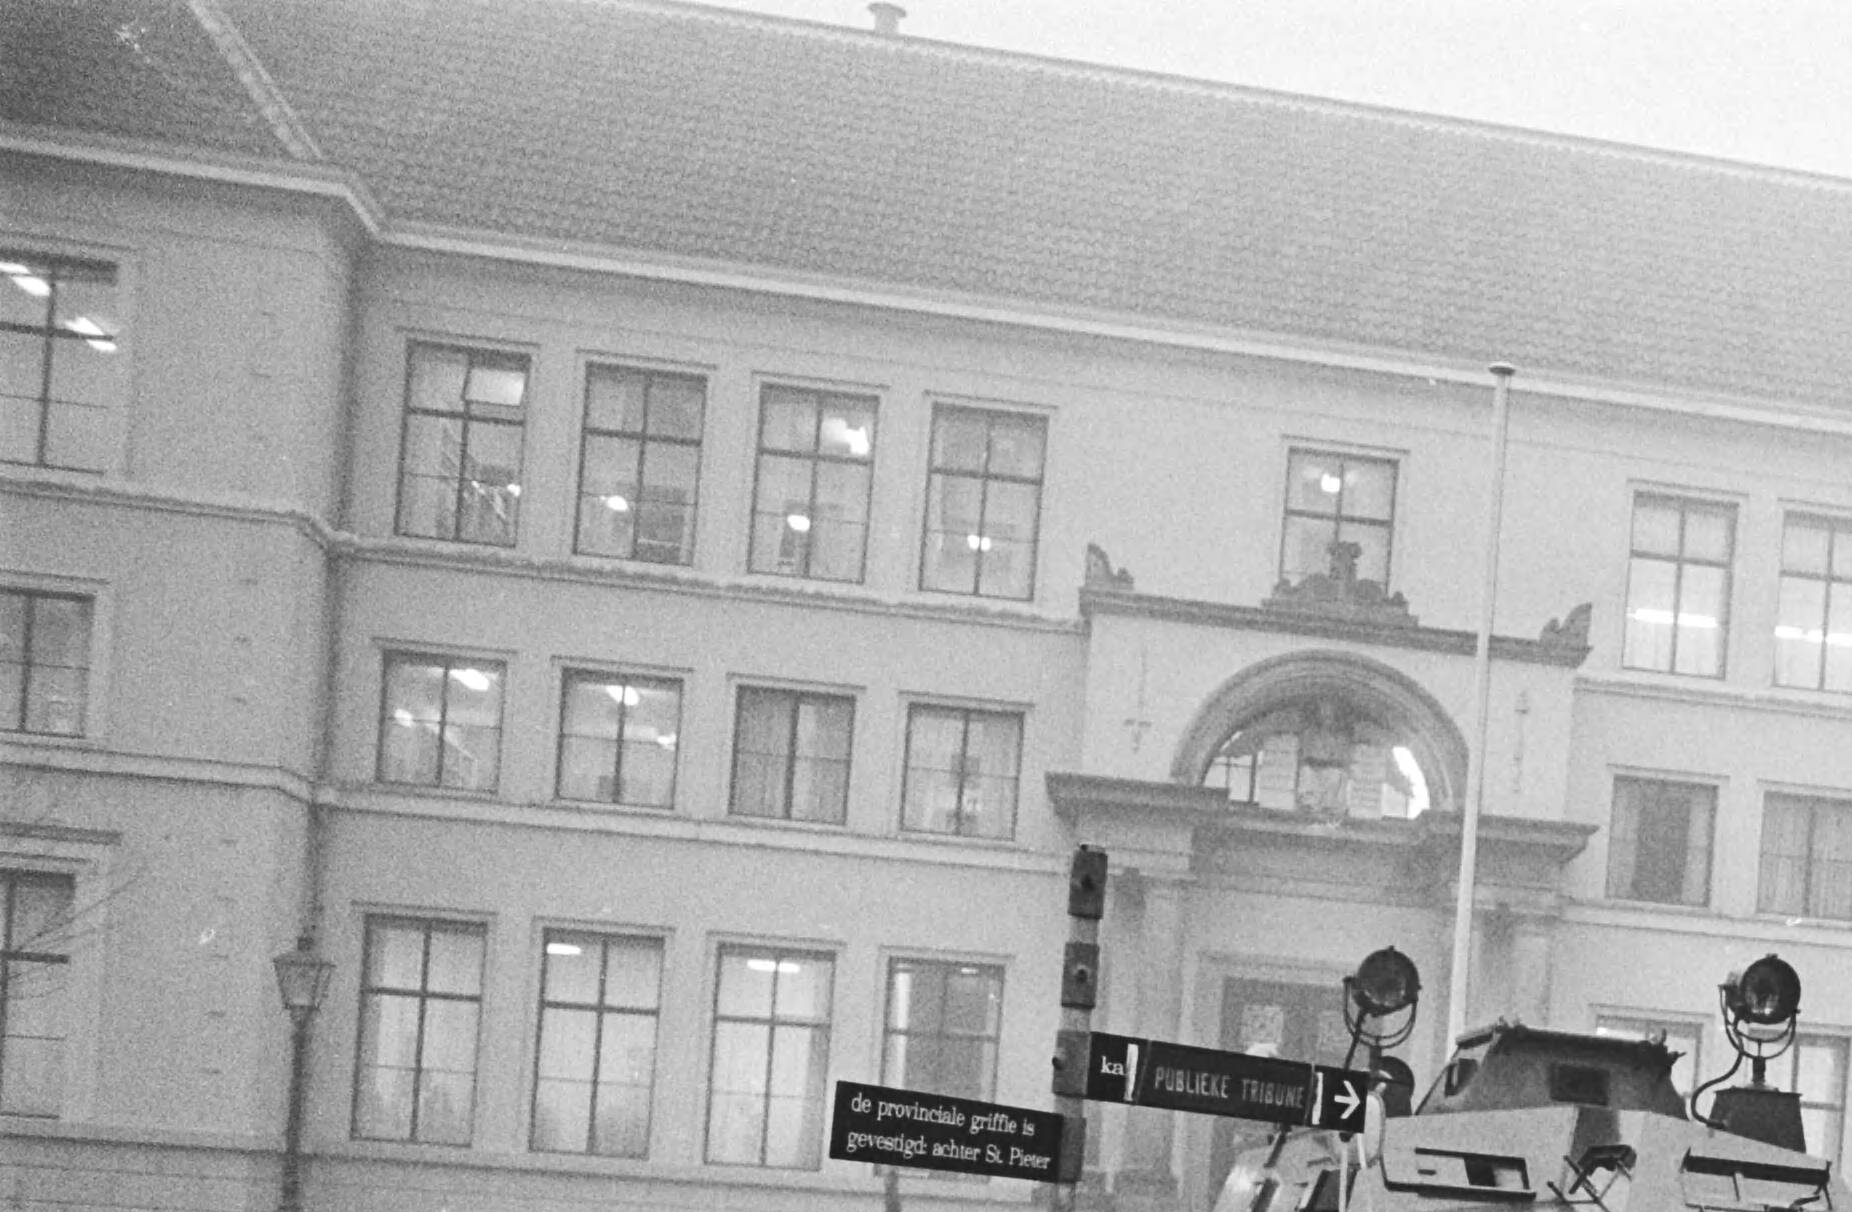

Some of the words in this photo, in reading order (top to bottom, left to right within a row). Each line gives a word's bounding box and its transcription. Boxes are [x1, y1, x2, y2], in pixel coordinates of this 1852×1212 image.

[1154, 1066, 1231, 1098] PUBLIEKE
[1242, 1078, 1304, 1108] TRIBUNE
[851, 1092, 871, 1113] de
[877, 1102, 965, 1127] provinciale
[970, 1113, 1017, 1134] griffie
[1022, 1118, 1035, 1136] is
[932, 1139, 981, 1161] achter
[1009, 1146, 1051, 1169] Pieter
